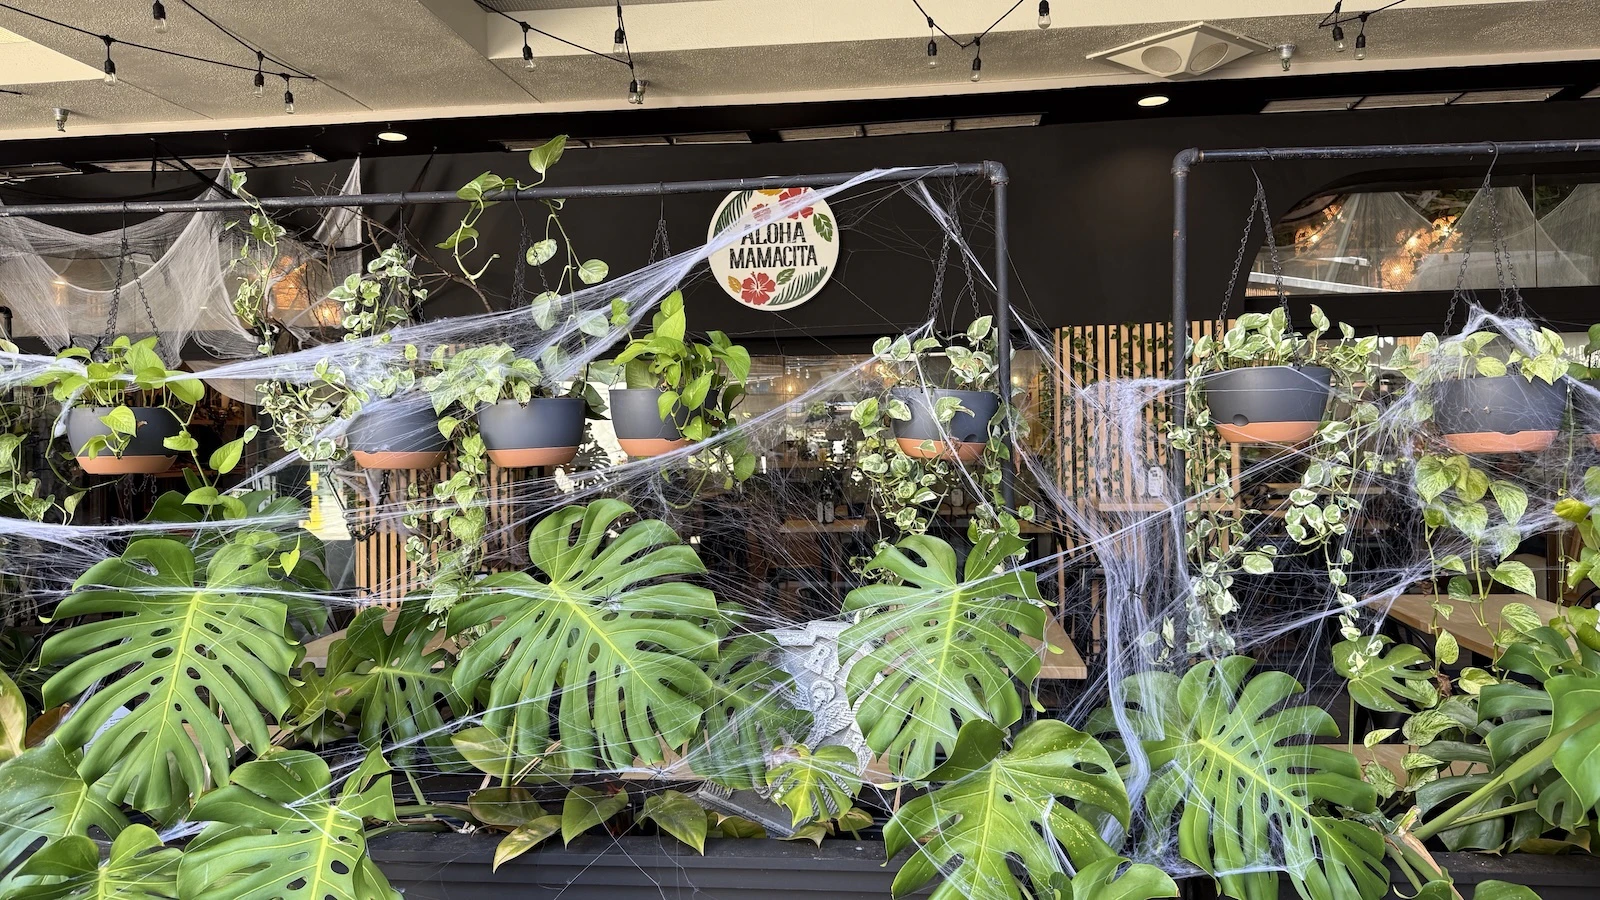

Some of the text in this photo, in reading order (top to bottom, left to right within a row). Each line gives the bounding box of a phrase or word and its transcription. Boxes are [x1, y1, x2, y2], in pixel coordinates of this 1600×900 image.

[741, 222, 806, 245] ALOHA
[729, 245, 818, 269] MAMACITA
[312, 464, 329, 472] HAPPY
